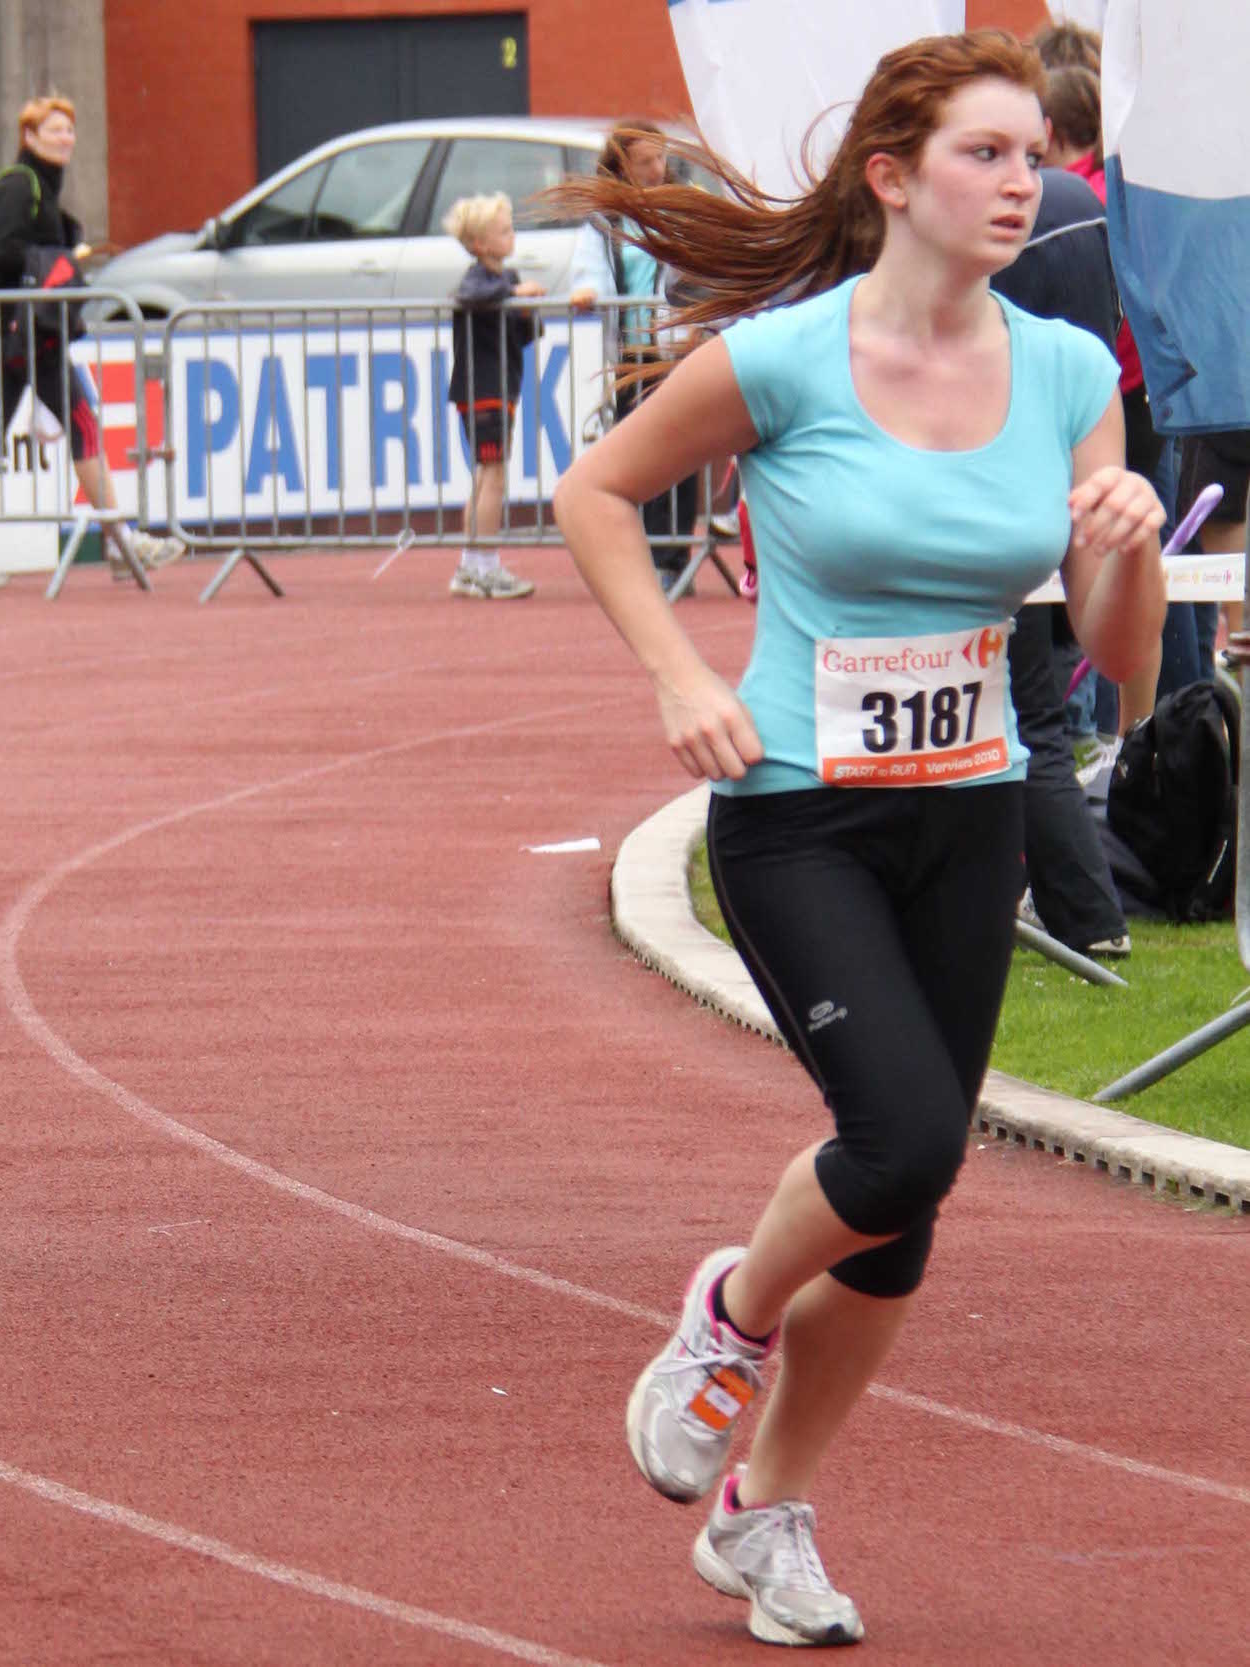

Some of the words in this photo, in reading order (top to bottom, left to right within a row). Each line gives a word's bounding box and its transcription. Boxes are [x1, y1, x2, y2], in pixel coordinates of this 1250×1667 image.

[185, 343, 576, 500] PATRIK
[823, 648, 952, 673] Carrefour
[861, 681, 983, 753] 3187
[833, 764, 875, 779] START
[926, 758, 974, 776] Verviers
[974, 749, 1000, 766] 2010
